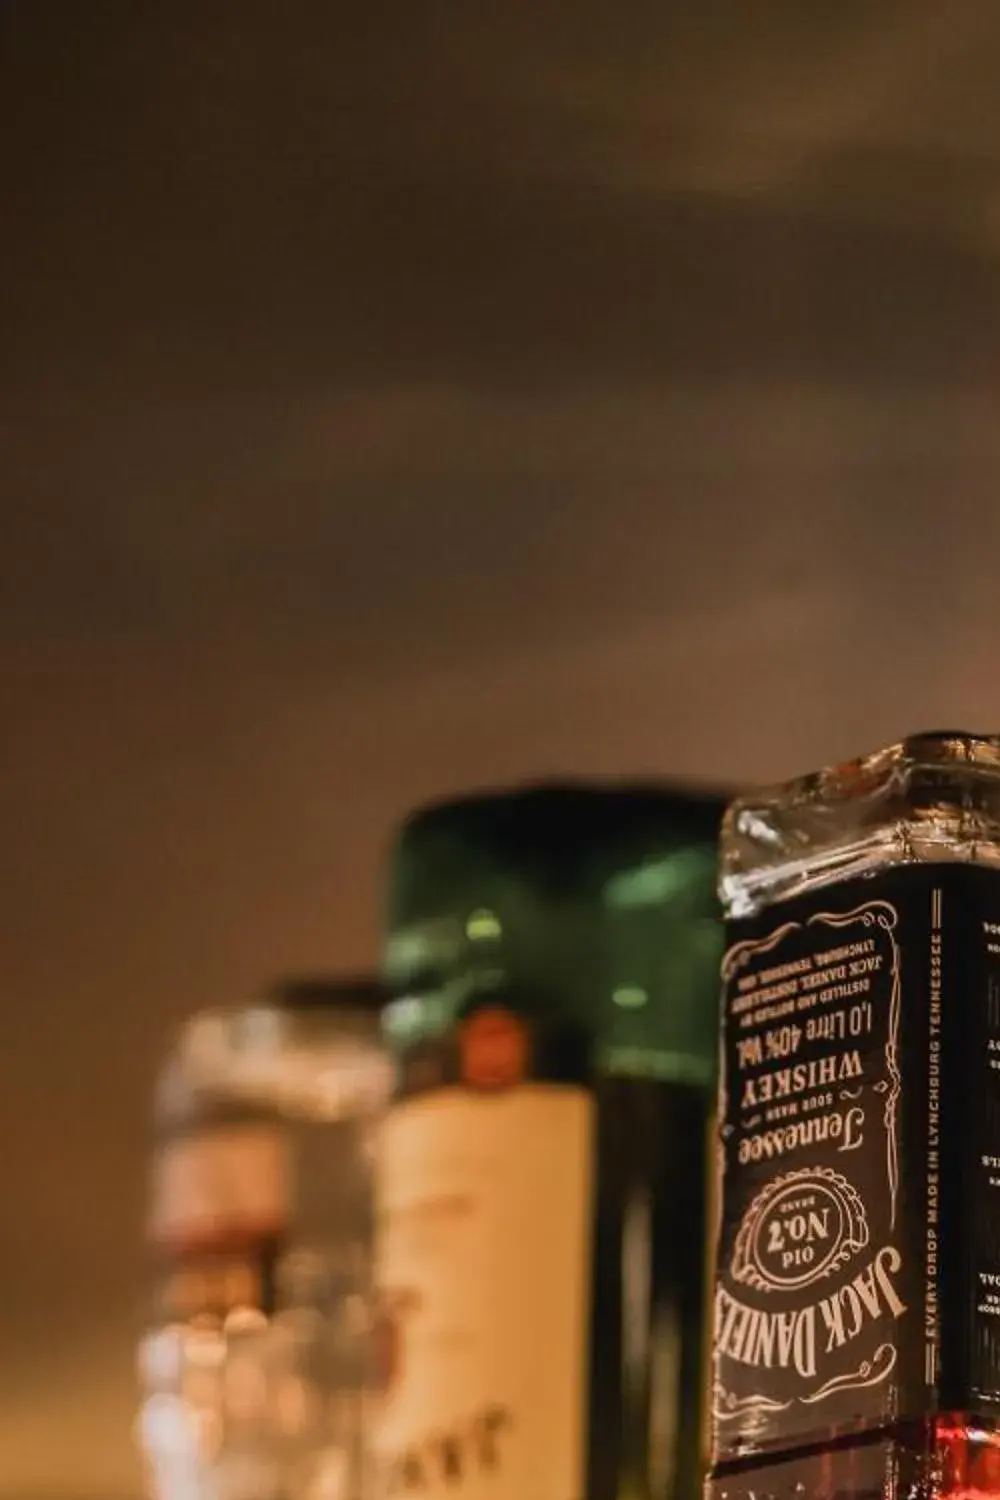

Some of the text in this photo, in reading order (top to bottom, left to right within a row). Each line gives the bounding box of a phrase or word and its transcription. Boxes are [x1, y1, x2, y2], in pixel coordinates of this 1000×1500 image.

[848, 955, 883, 977] JACK
[820, 979, 869, 1003] DISTILLED
[765, 1023, 801, 1059] 40%
[806, 1010, 845, 1041] Litre
[741, 1049, 864, 1108] WHISKEY
[765, 1093, 833, 1121] SOUR MASH
[738, 1107, 864, 1164] Tennessee
[925, 934, 941, 1337] EVERY DROP MADE IN LYNCHBURG TENNESSEE
[767, 1208, 830, 1253] No.7
[781, 1246, 814, 1268] Old
[818, 1246, 908, 1353] JACK
